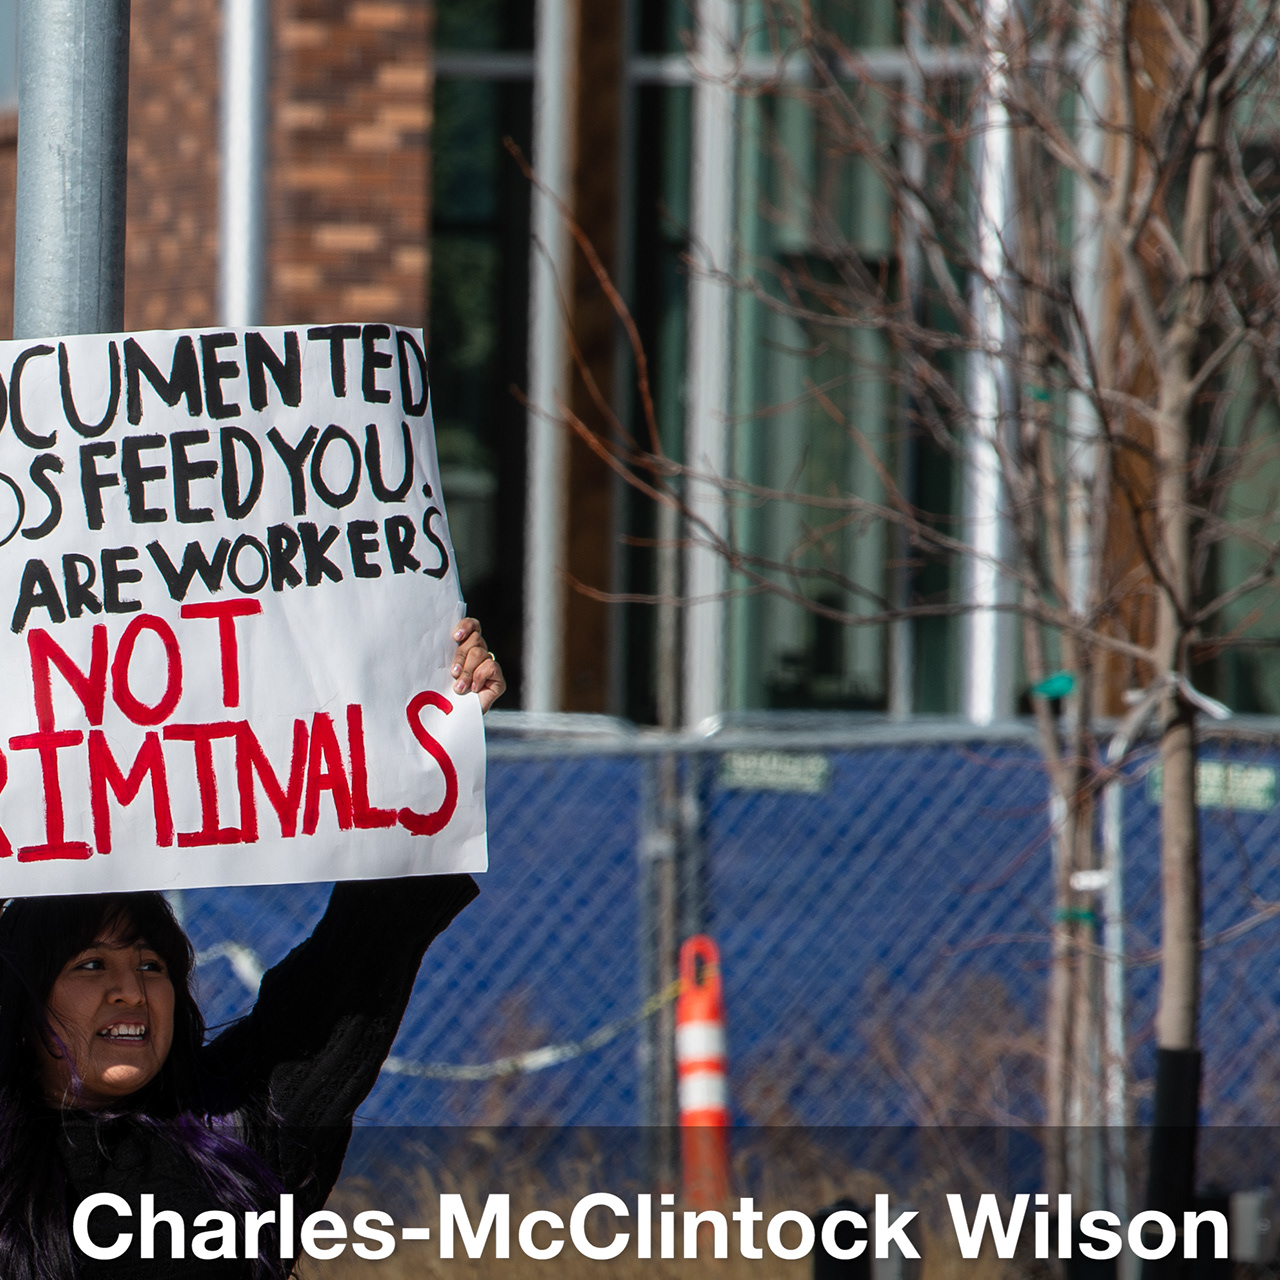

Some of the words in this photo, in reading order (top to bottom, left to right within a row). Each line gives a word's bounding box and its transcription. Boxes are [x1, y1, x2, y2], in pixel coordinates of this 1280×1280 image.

[80, 427, 264, 531] FEED
[267, 421, 434, 516] YOU.
[10, 545, 143, 634] ARE
[146, 505, 449, 602] WORKERS
[27, 597, 263, 737] NOT
